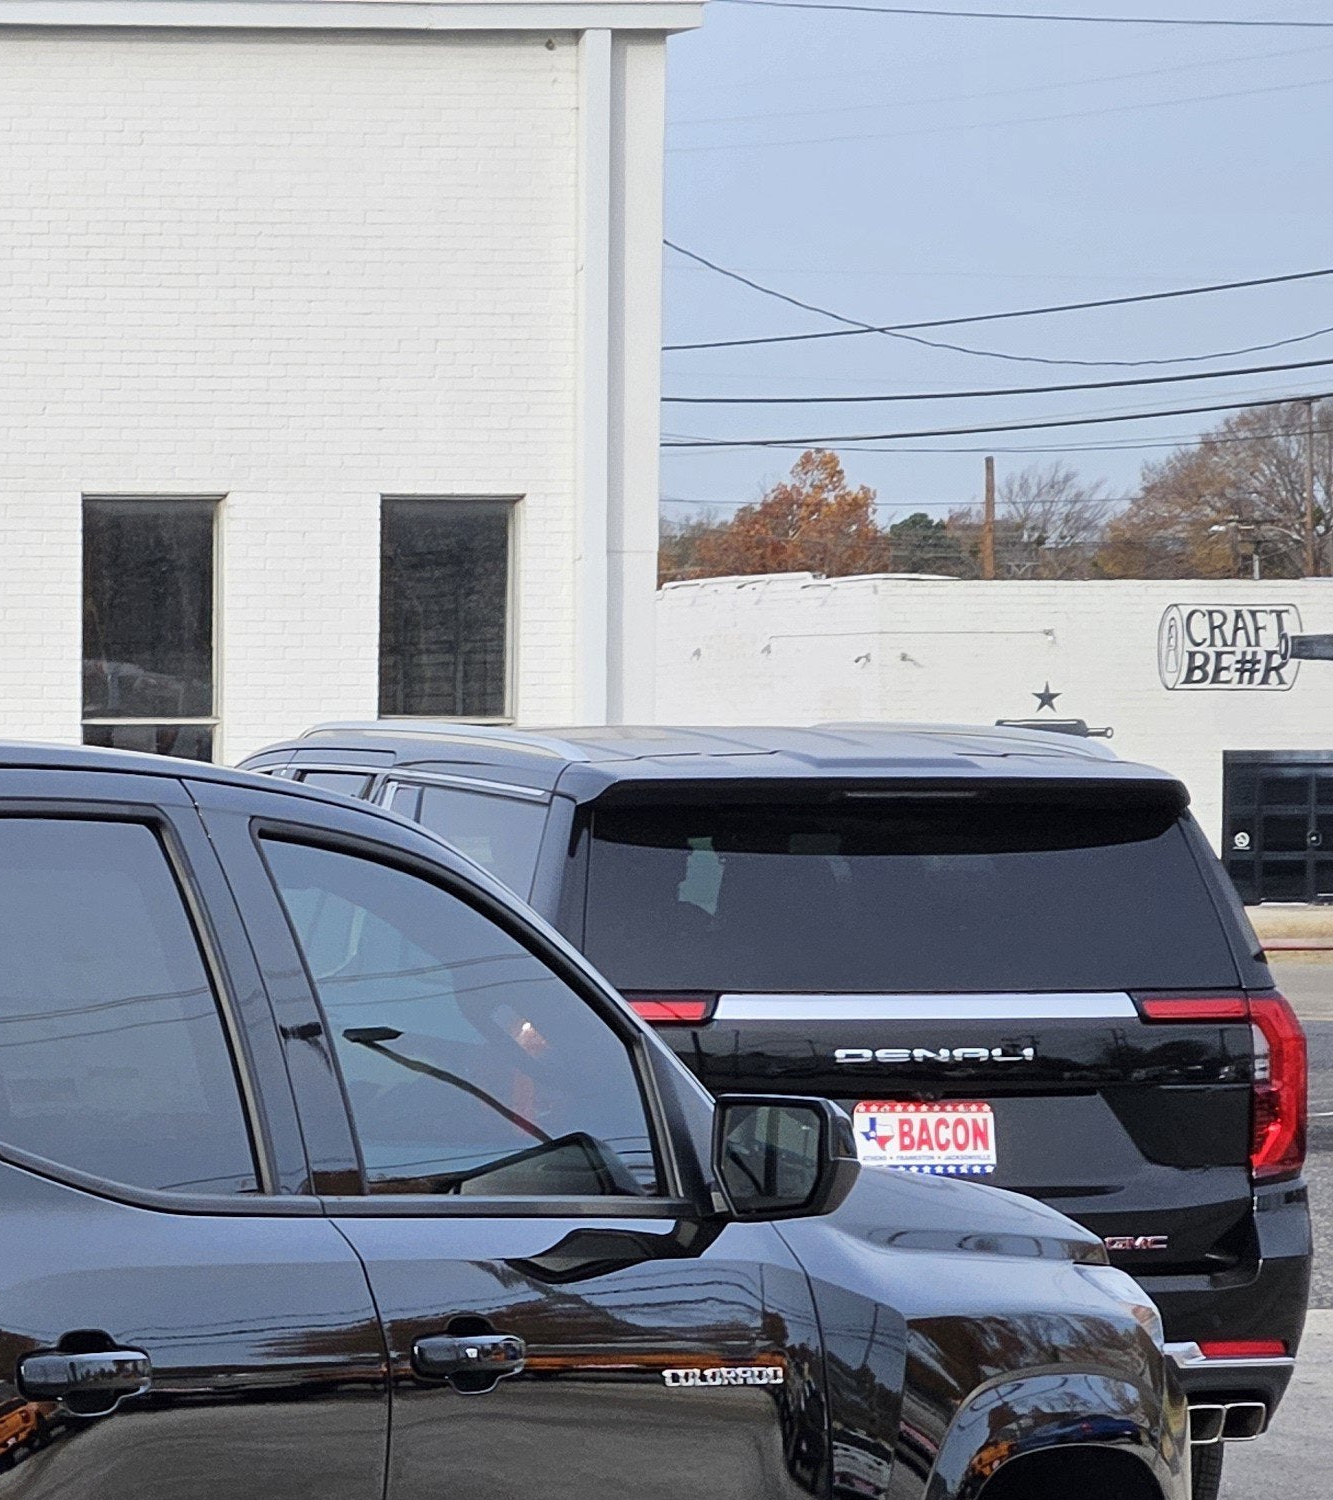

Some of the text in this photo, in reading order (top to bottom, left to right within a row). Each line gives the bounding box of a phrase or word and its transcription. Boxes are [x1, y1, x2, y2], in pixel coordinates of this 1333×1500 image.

[1185, 608, 1290, 648] CRAFT
[834, 1048, 1035, 1064] DENALI
[898, 1117, 990, 1152] BACON
[1103, 1235, 1169, 1251] GMC
[661, 1365, 785, 1388] COLORADO
